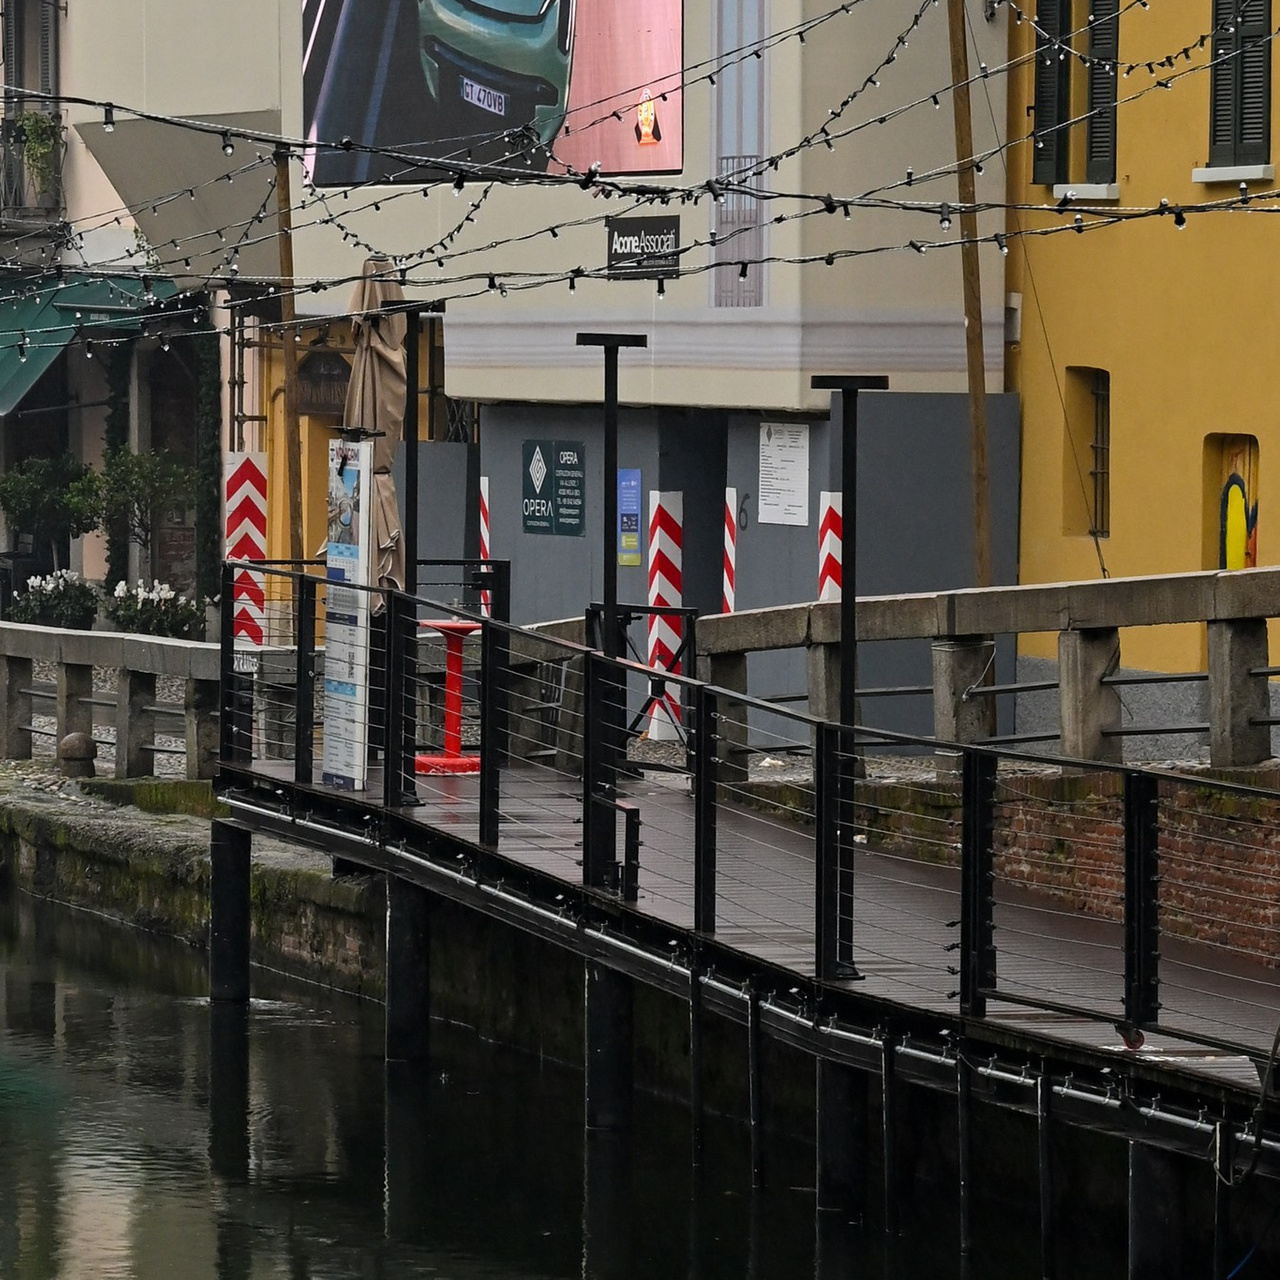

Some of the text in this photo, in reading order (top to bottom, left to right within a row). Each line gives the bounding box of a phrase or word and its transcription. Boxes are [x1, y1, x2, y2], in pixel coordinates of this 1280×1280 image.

[559, 451, 579, 464] OPERA
[523, 498, 554, 517] OPERA
[739, 492, 751, 531] 6
